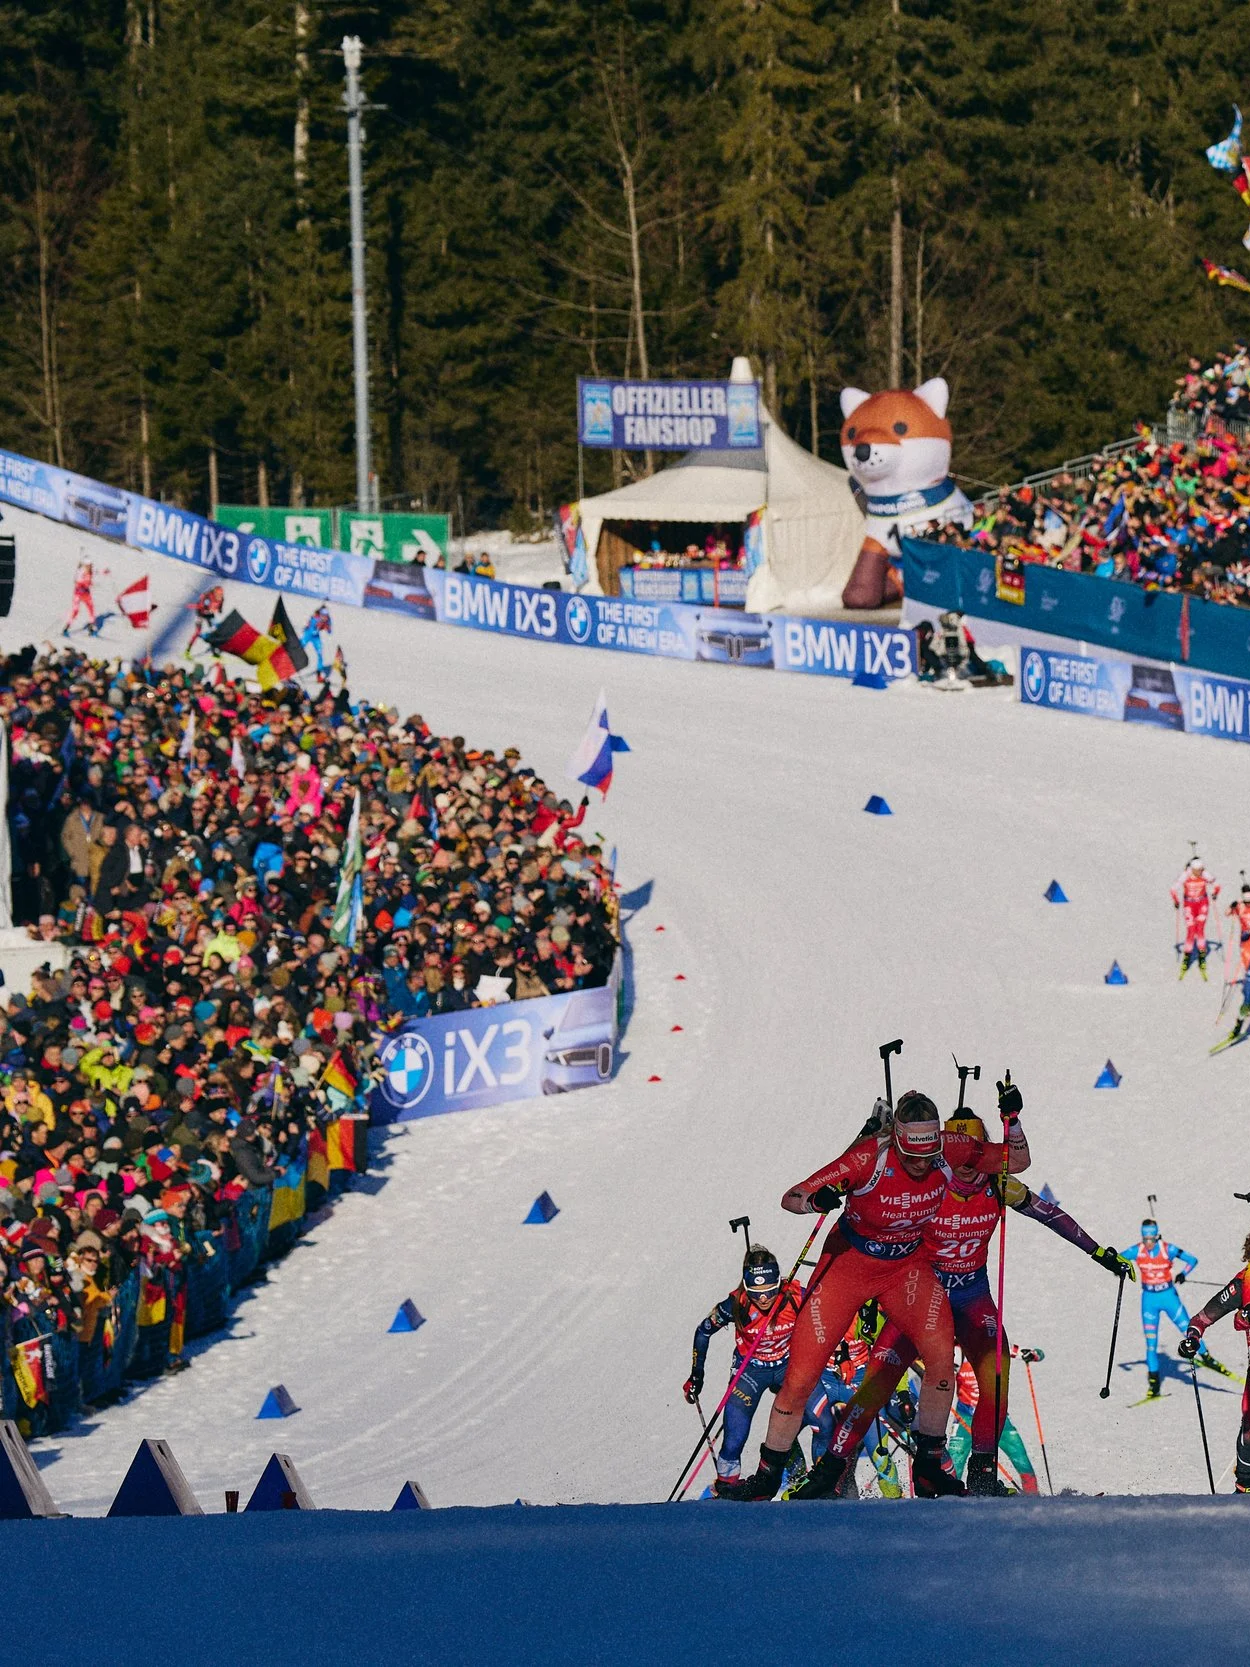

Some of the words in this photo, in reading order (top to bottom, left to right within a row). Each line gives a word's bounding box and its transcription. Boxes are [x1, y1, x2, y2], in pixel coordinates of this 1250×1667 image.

[612, 384, 727, 416] OFFIZIELLER
[624, 415, 717, 446] FANSHOP
[136, 503, 200, 560] BMW
[201, 525, 240, 574] iX3
[275, 544, 300, 568] THE
[300, 549, 333, 574] FIRST
[274, 566, 293, 587] OF
[444, 578, 510, 628] BMW
[514, 590, 558, 637] iX3
[596, 600, 623, 624] THE
[623, 604, 662, 627] FIRST
[597, 623, 616, 644] OF
[615, 626, 628, 646] A
[784, 622, 857, 672] BMW
[863, 630, 913, 679] iX3
[1048, 656, 1071, 681] THE
[1070, 659, 1099, 684] FIRST
[1049, 681, 1064, 703] OF
[1189, 681, 1245, 735] BMW
[443, 1018, 533, 1096] iX3
[807, 1170, 841, 1188] helvetia
[880, 1184, 946, 1209] VIESSMANN
[881, 1210, 907, 1219] Heat
[930, 1212, 997, 1230] VIESSMANN
[934, 1229, 958, 1238] Heat
[959, 1229, 990, 1239] pumps
[936, 1238, 982, 1259] 20
[809, 1297, 827, 1345] Sunrise
